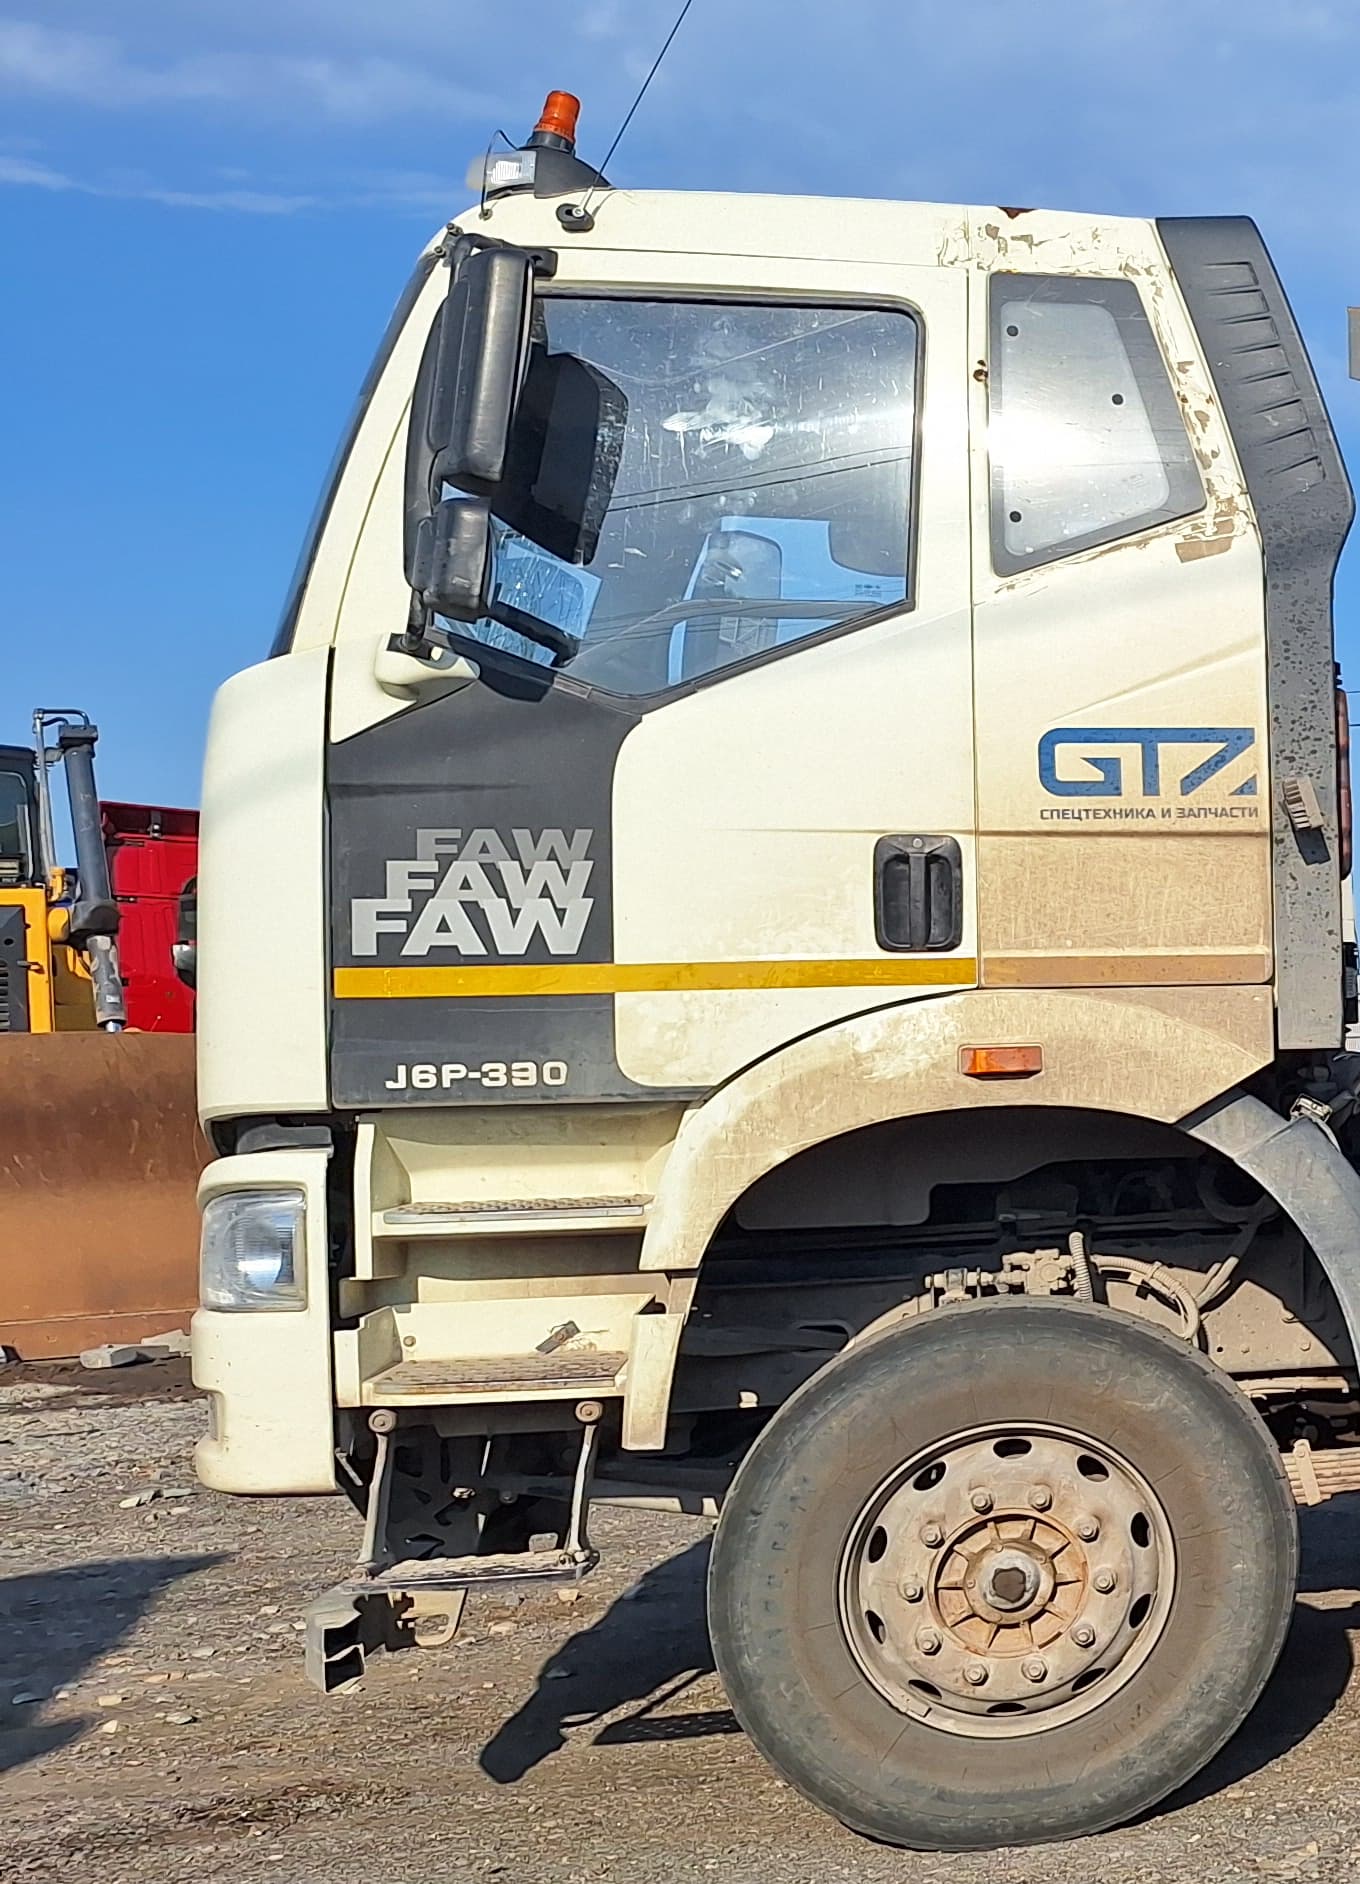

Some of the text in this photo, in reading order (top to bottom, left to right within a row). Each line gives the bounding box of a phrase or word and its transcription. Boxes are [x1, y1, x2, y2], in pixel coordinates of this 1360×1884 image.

[1038, 727, 1258, 797] GTZ
[1040, 806, 1259, 822] СПЕЦТЕХНИКА И ЗАПЧАСТИ
[416, 828, 594, 870] FAW
[386, 860, 595, 909] FAW
[351, 898, 595, 956] FAW
